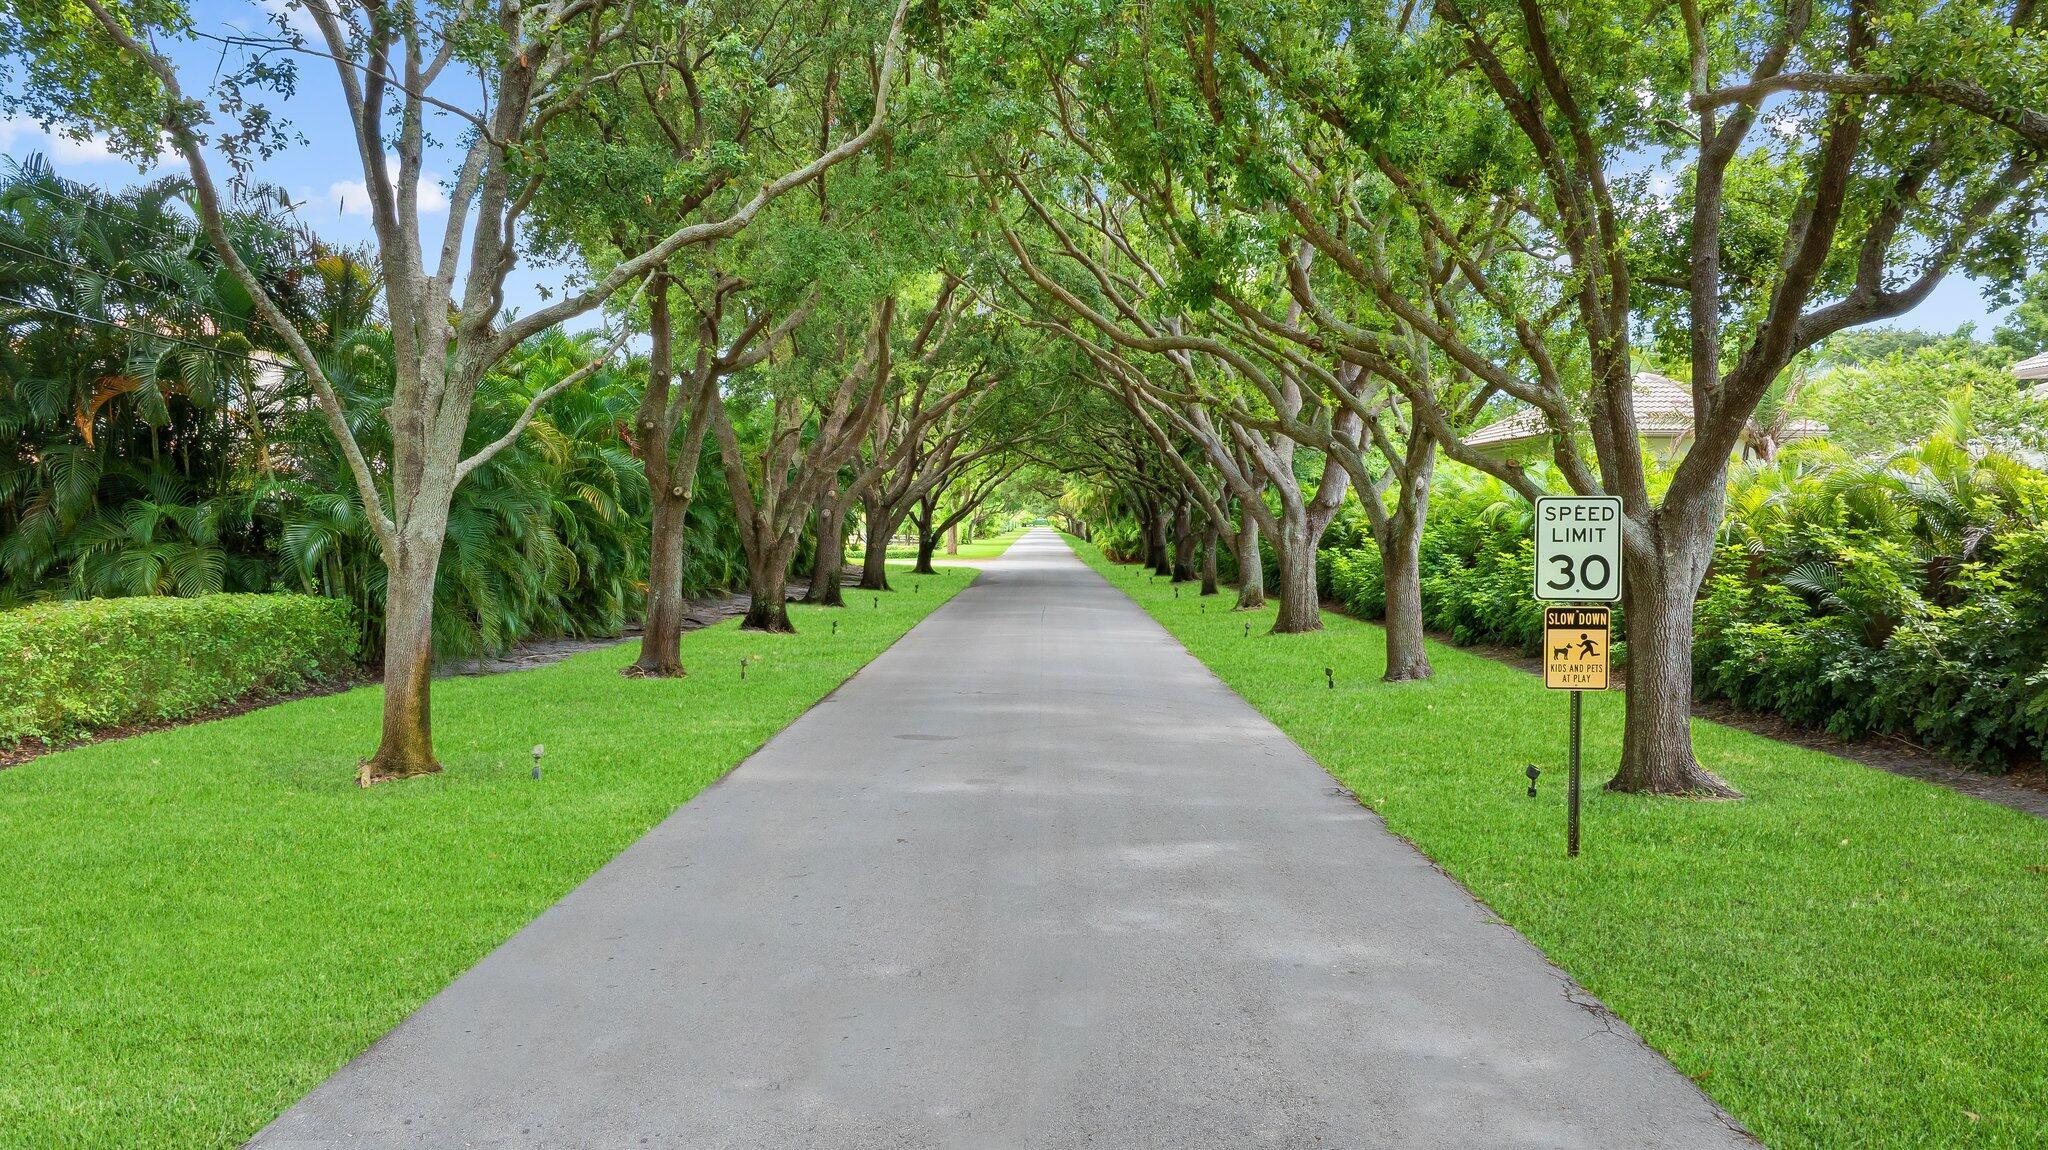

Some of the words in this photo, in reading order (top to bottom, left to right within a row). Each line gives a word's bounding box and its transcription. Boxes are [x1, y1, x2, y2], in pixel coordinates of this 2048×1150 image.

[1545, 506, 1614, 521] SPEED
[1552, 528, 1606, 542] LIMIT
[1546, 554, 1610, 591] 30
[1548, 612, 1575, 625] SLOW
[1578, 612, 1607, 625] DOWN
[1550, 664, 1567, 673] KIDS
[1569, 664, 1584, 673] AND
[1586, 664, 1603, 673] PETS
[1562, 674, 1571, 683] AT
[1573, 674, 1591, 683] PLAY
